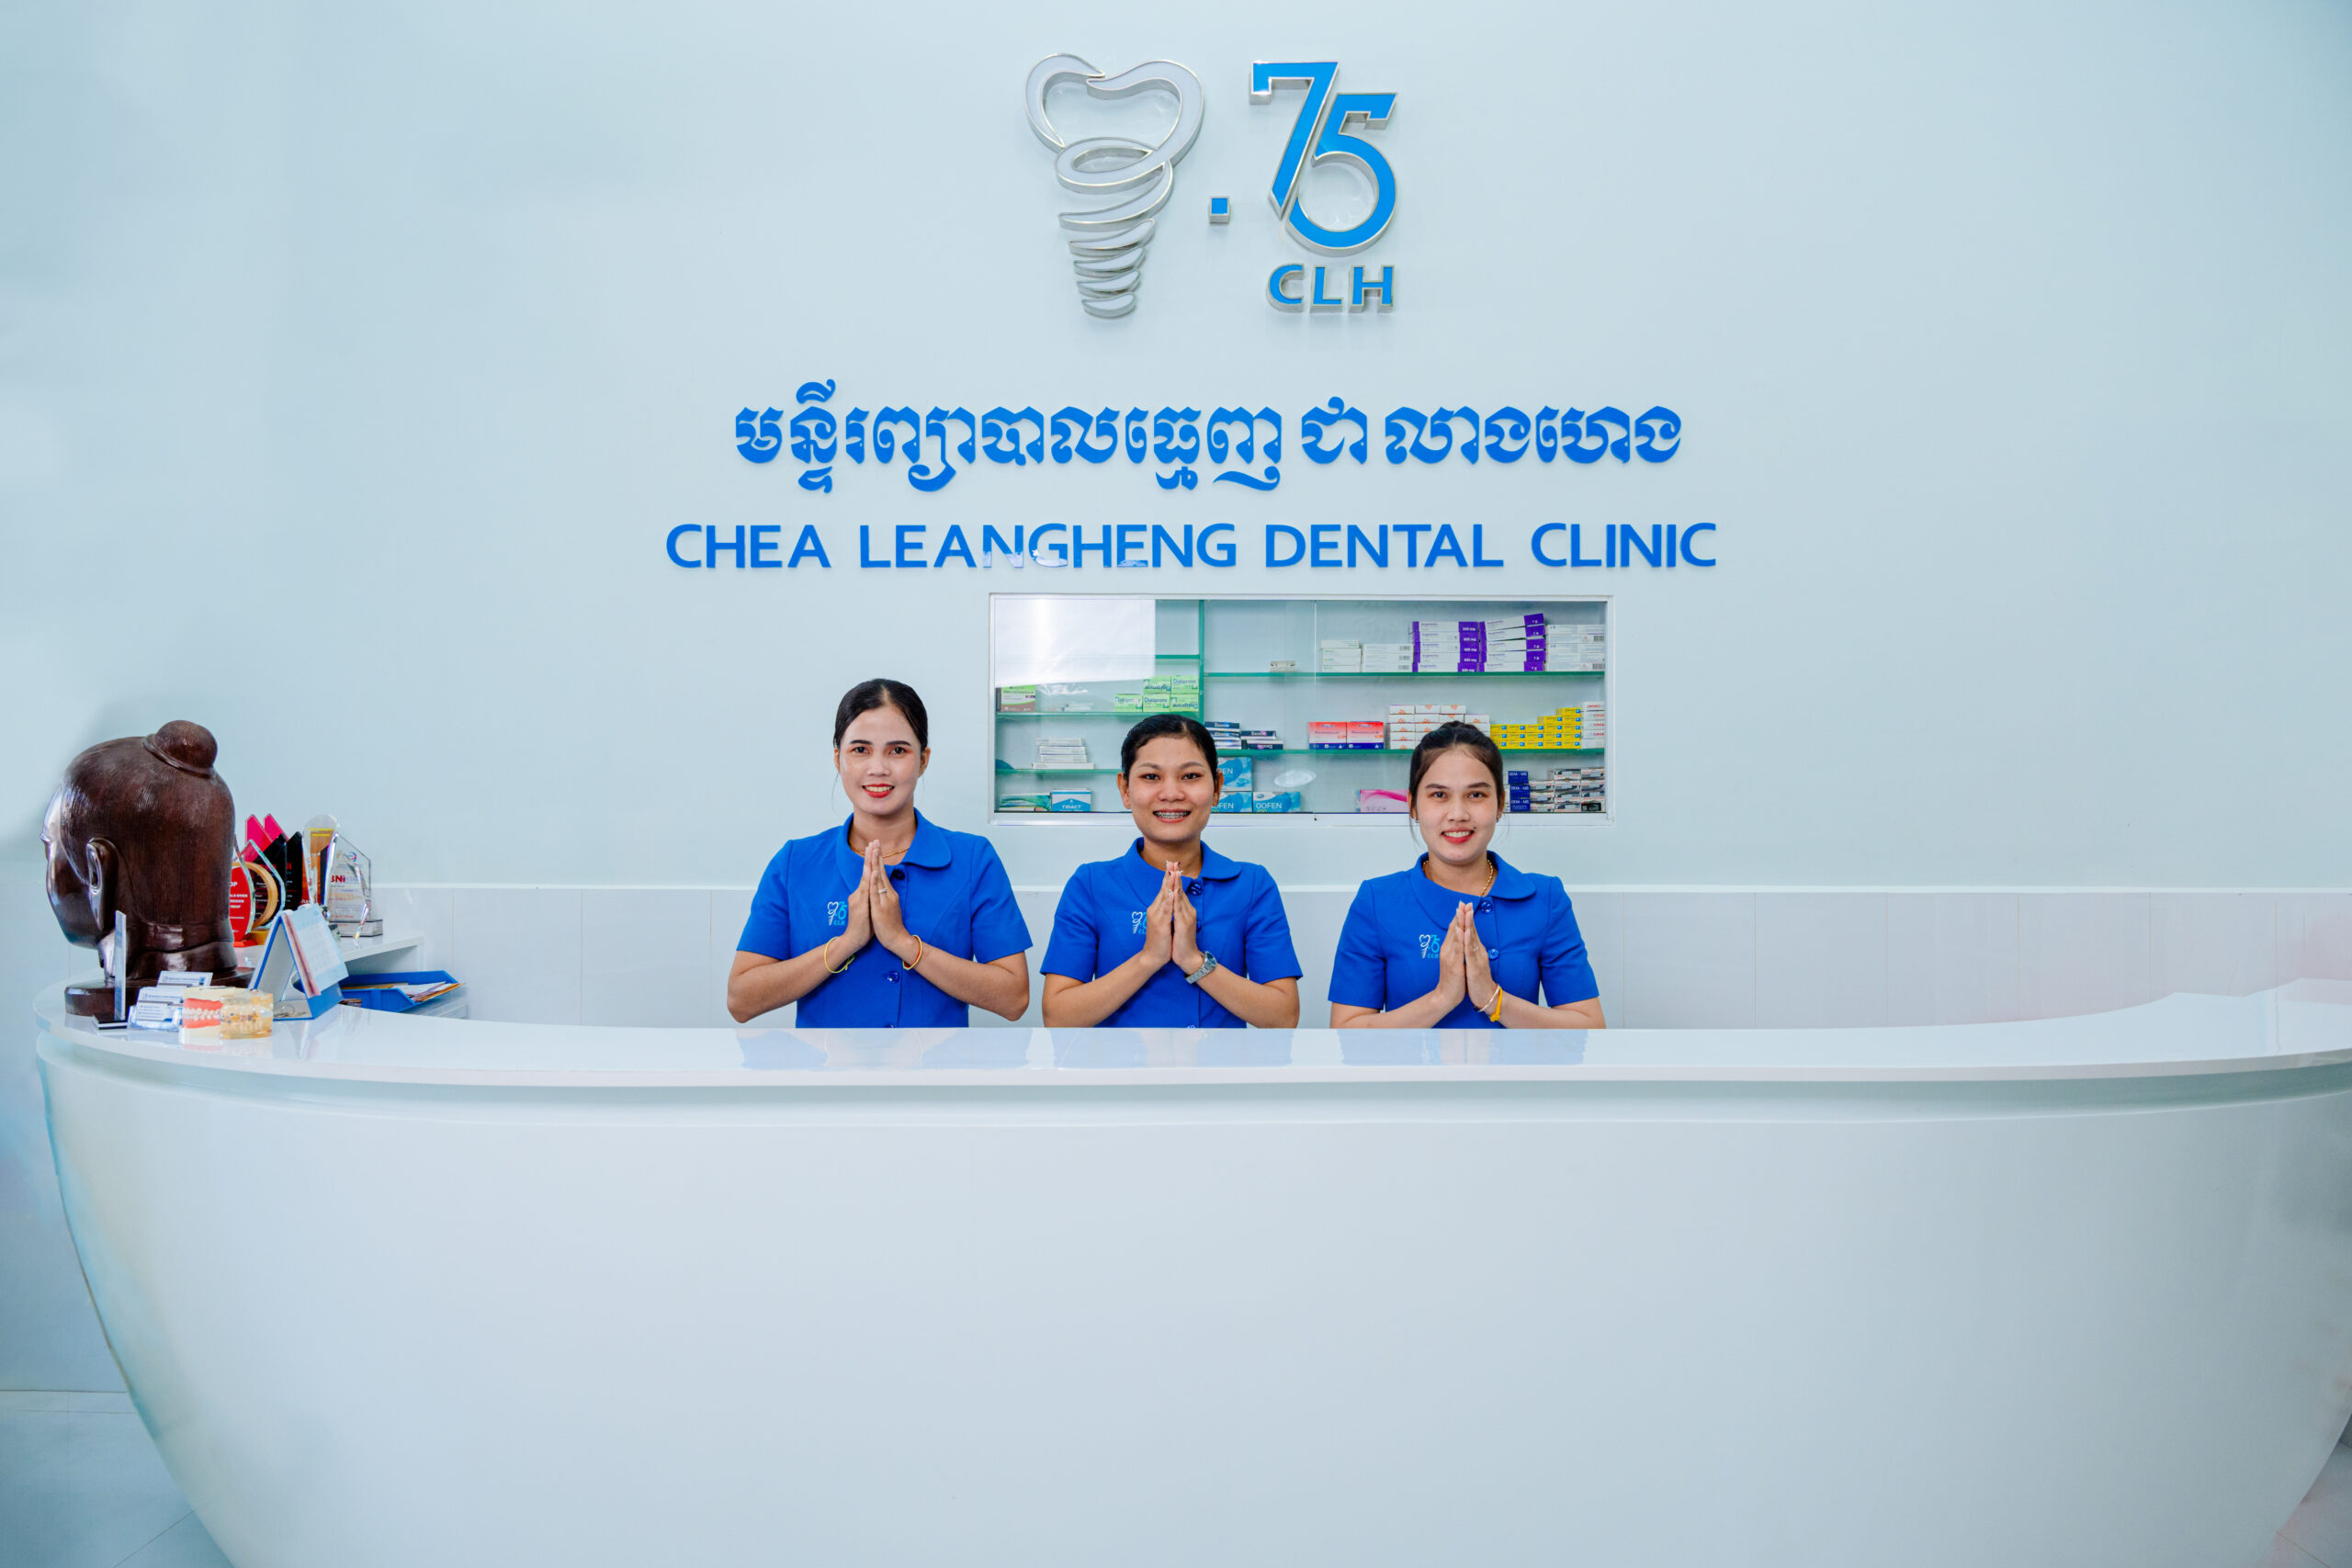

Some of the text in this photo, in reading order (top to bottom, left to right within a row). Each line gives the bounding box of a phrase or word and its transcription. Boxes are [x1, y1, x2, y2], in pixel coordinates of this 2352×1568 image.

[1266, 264, 1396, 313] CLH
[665, 522, 1717, 570] CHEA LEANGHENG DENTAL CLINIC
